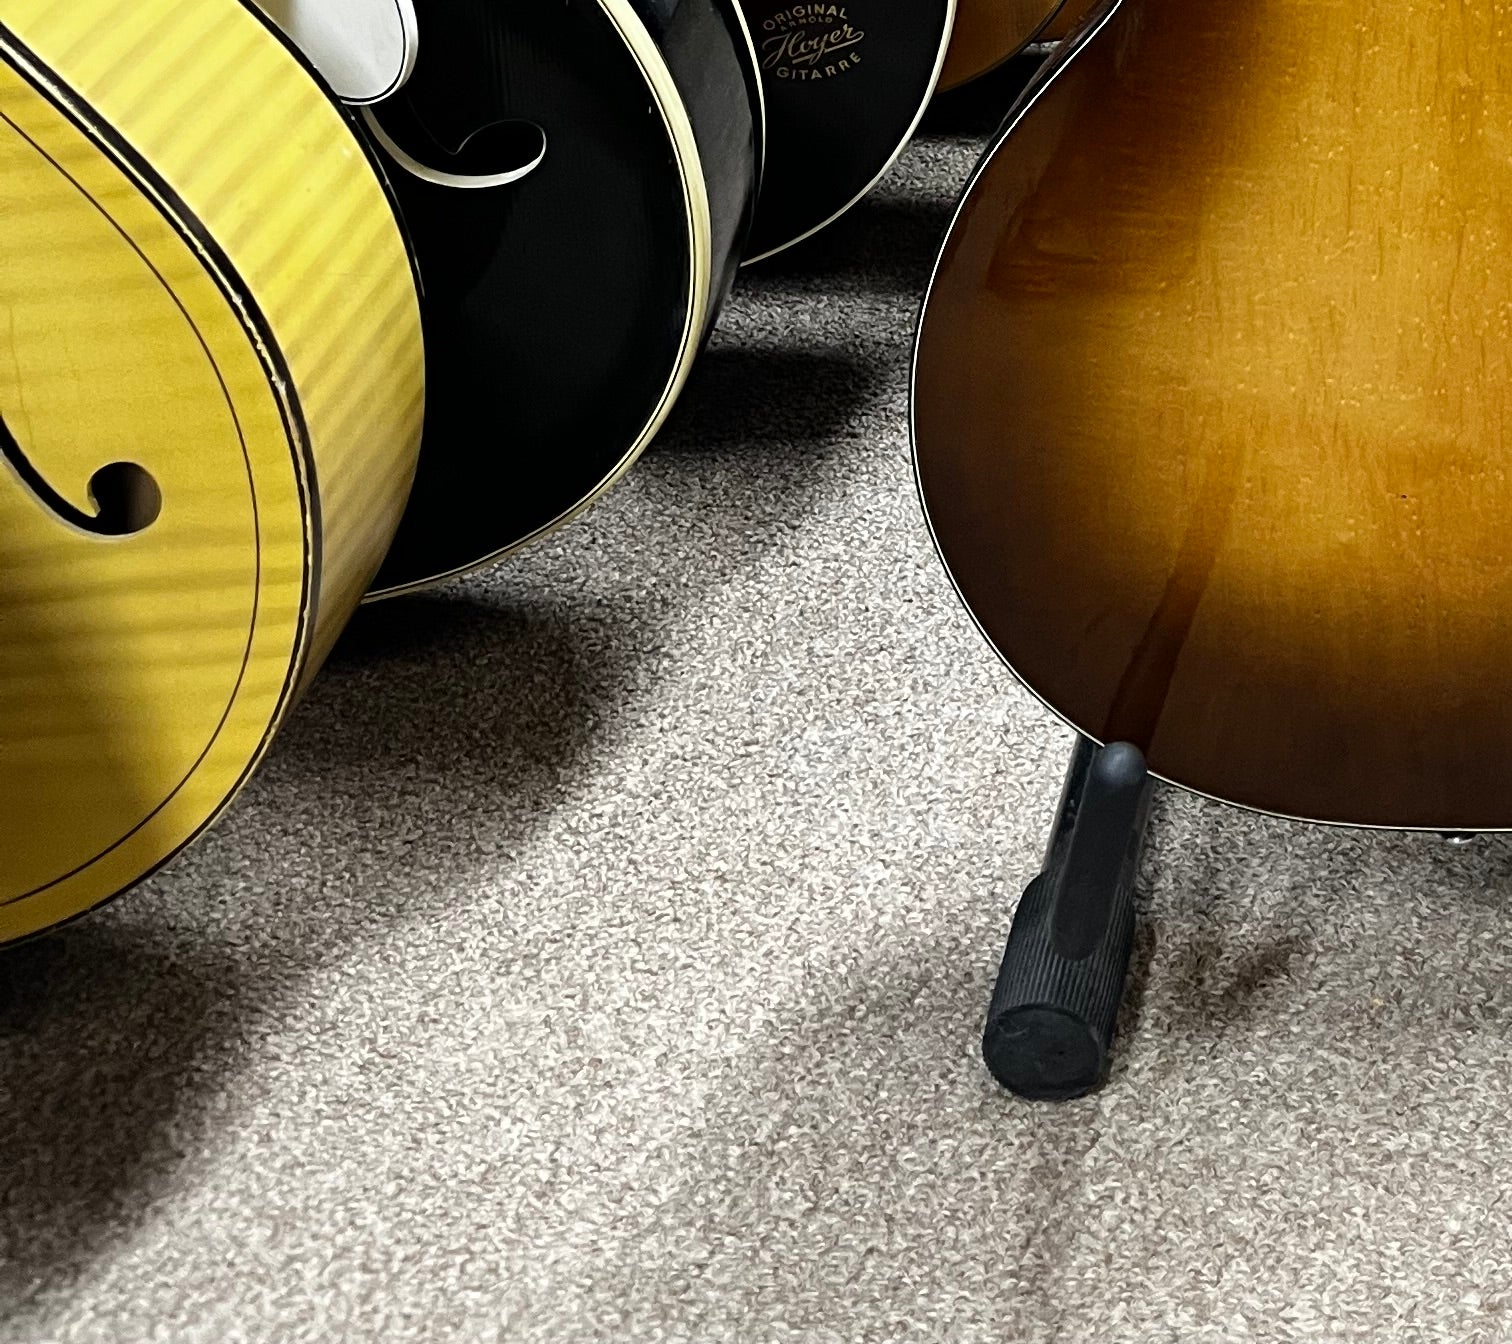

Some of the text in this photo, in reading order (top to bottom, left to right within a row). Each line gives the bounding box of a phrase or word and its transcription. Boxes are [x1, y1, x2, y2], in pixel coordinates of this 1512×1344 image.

[763, 3, 848, 31] ORIGINAL
[761, 23, 865, 70] Hoyer
[776, 51, 862, 80] GITARRE
